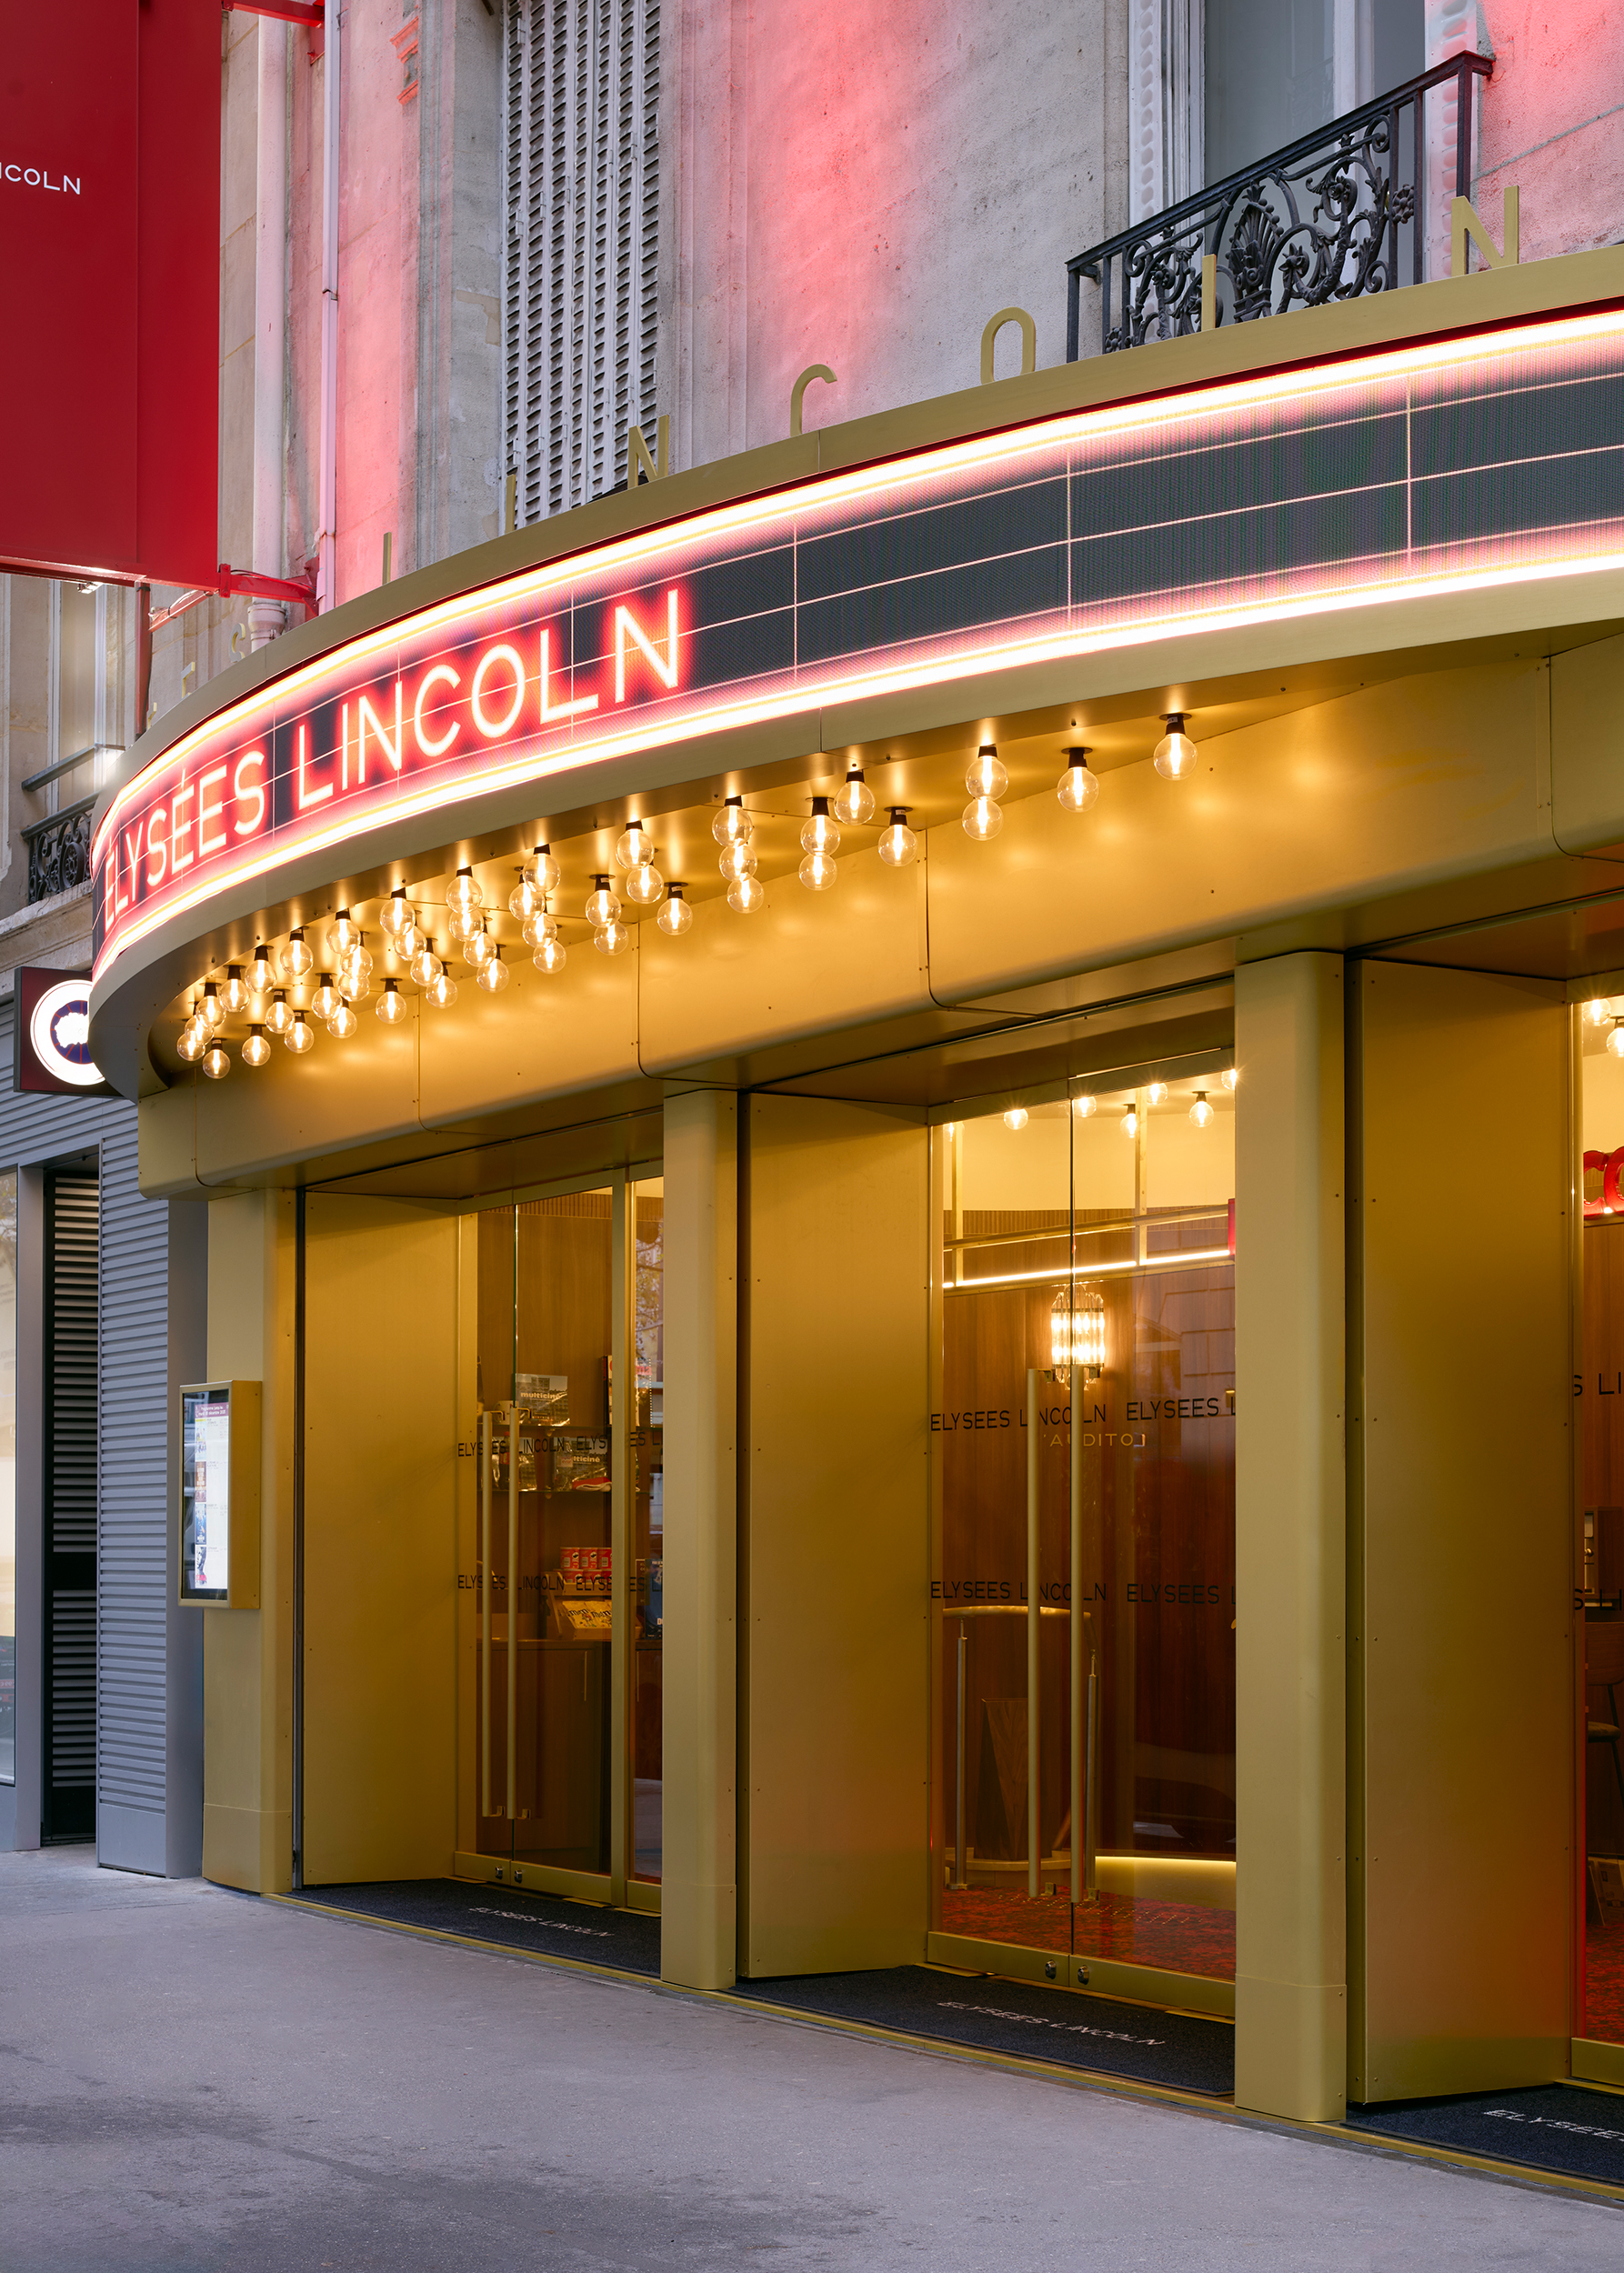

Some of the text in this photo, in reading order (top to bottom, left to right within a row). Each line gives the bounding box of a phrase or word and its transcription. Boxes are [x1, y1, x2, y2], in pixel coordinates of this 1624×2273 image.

[296, 589, 680, 810] LINCOLN
[930, 1410, 1010, 1432] ELYSEES
[1126, 1397, 1219, 1421] ELYSEES
[930, 1581, 1010, 1600] ELYSEES
[1126, 1583, 1219, 1605] ELYSEES
[1483, 2109, 1624, 2142] ELYSEE
